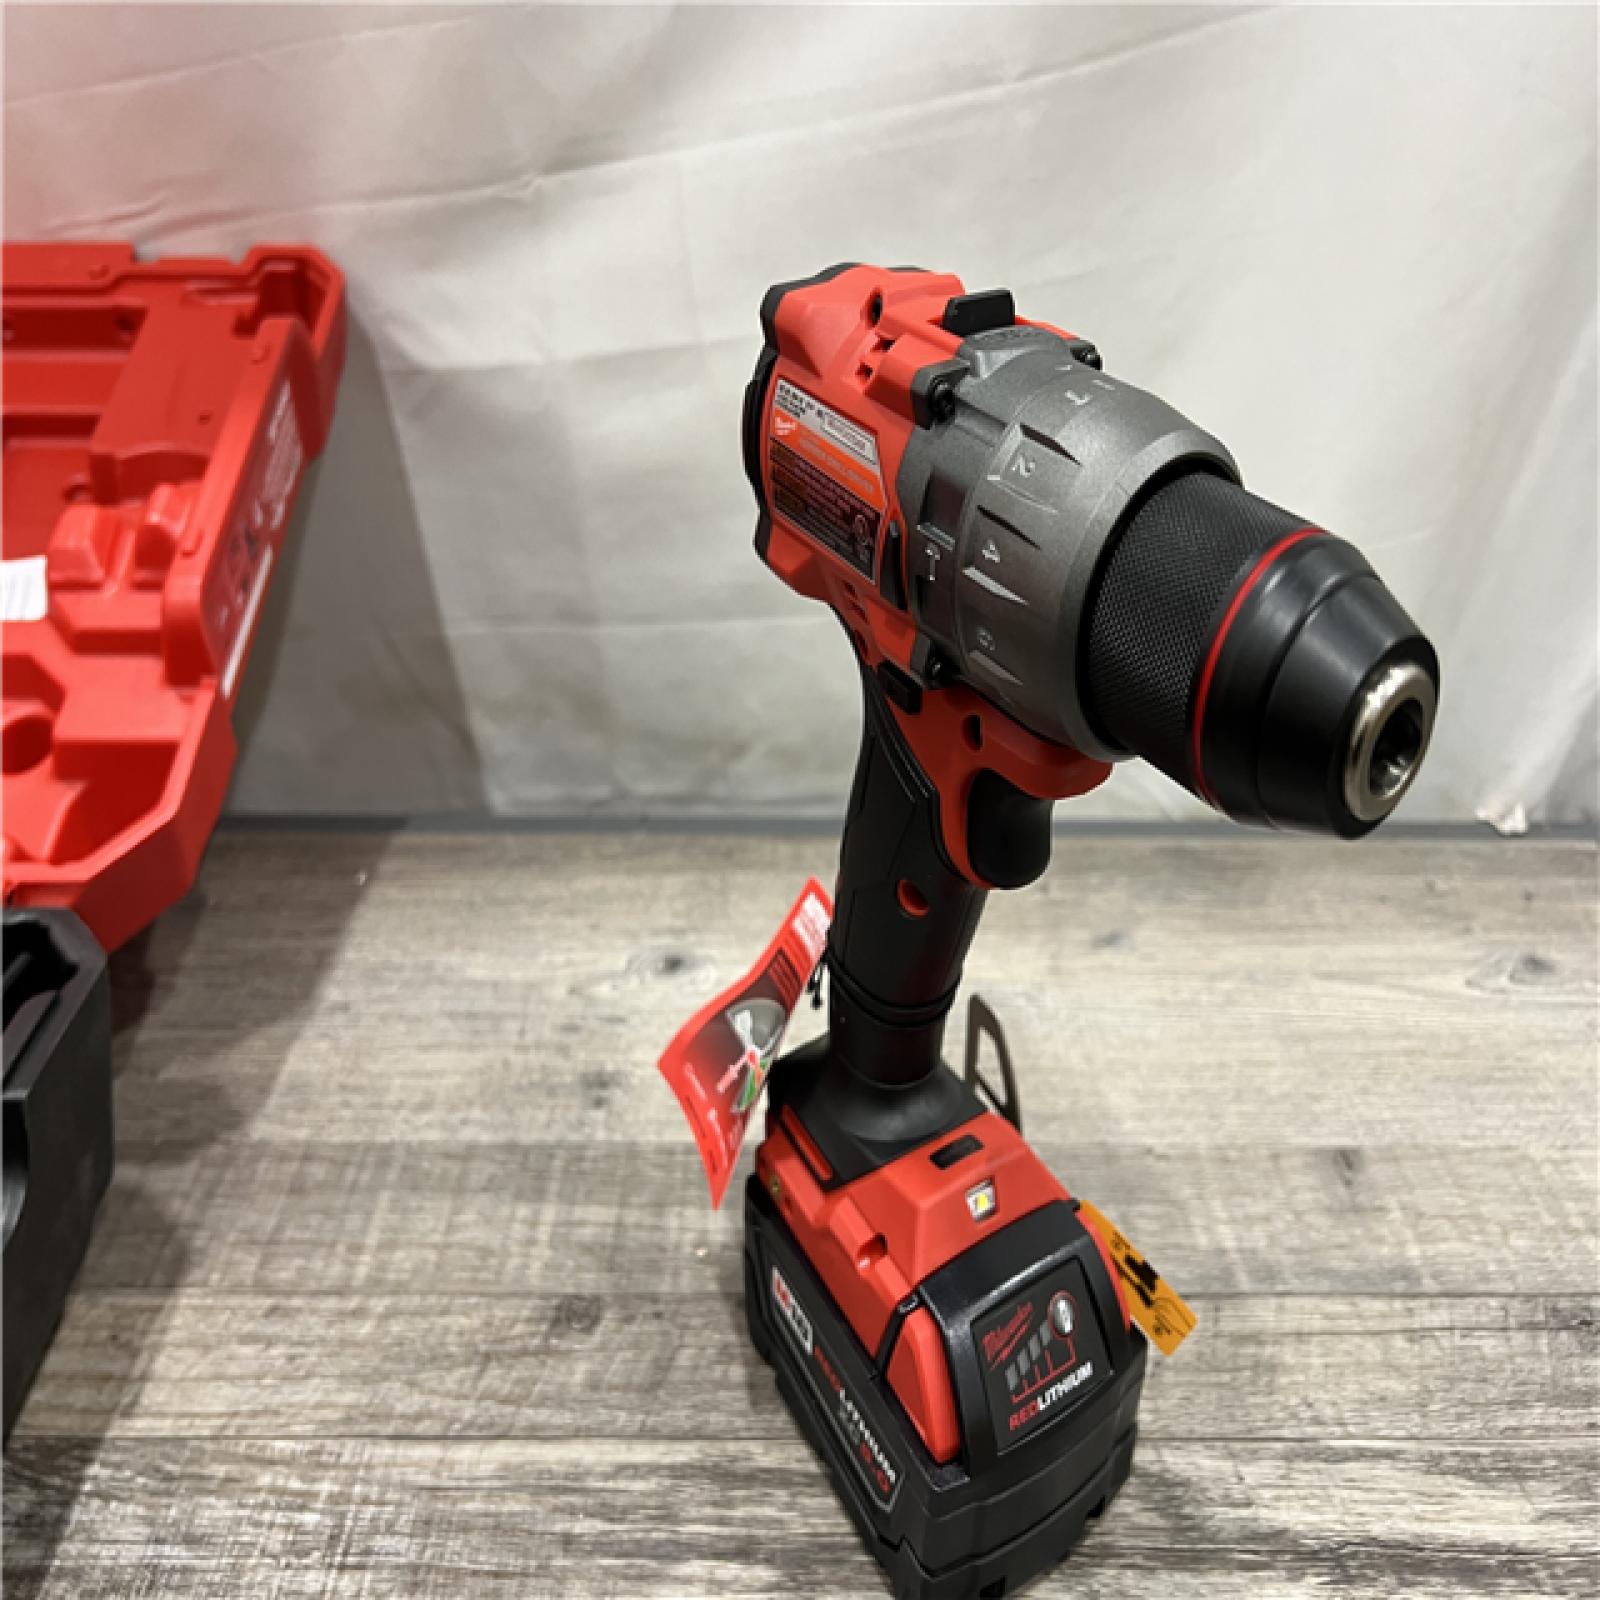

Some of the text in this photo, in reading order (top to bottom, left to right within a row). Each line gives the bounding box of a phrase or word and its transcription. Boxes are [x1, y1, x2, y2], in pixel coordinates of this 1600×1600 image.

[1011, 456, 1036, 478] 2
[981, 539, 1001, 563] 4
[1008, 1361, 1094, 1431] REDLITHIUM
